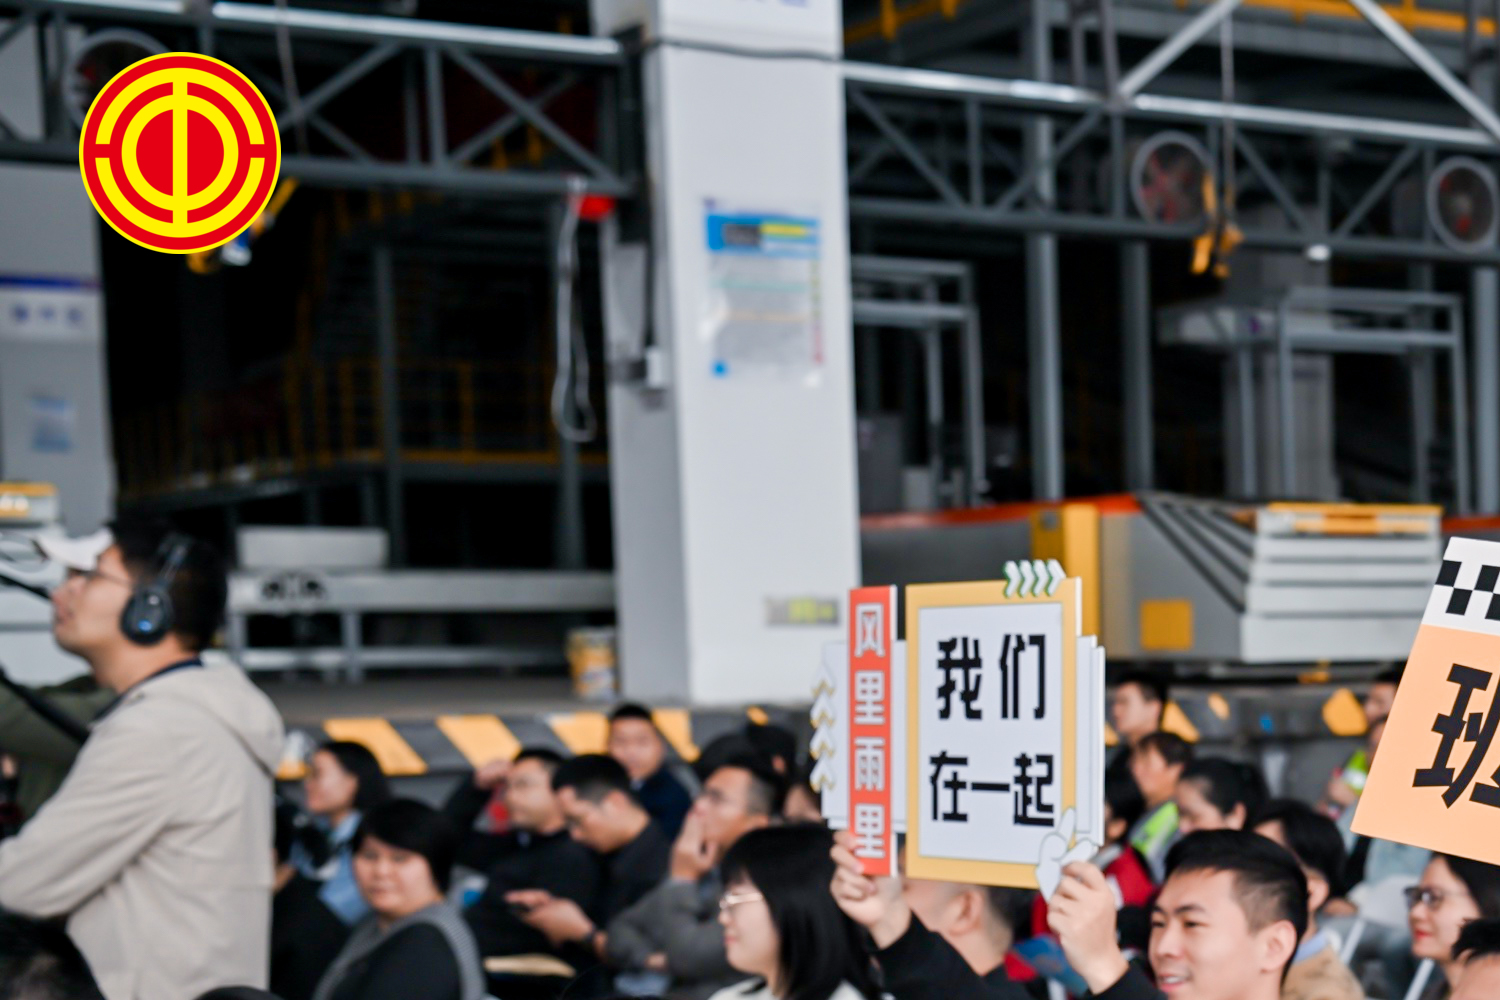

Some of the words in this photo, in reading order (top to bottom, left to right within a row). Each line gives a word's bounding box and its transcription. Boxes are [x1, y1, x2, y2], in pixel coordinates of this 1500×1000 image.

[936, 634, 1047, 720] 我们
[854, 603, 885, 858] 风里雨里
[929, 750, 1055, 827] 在一起
